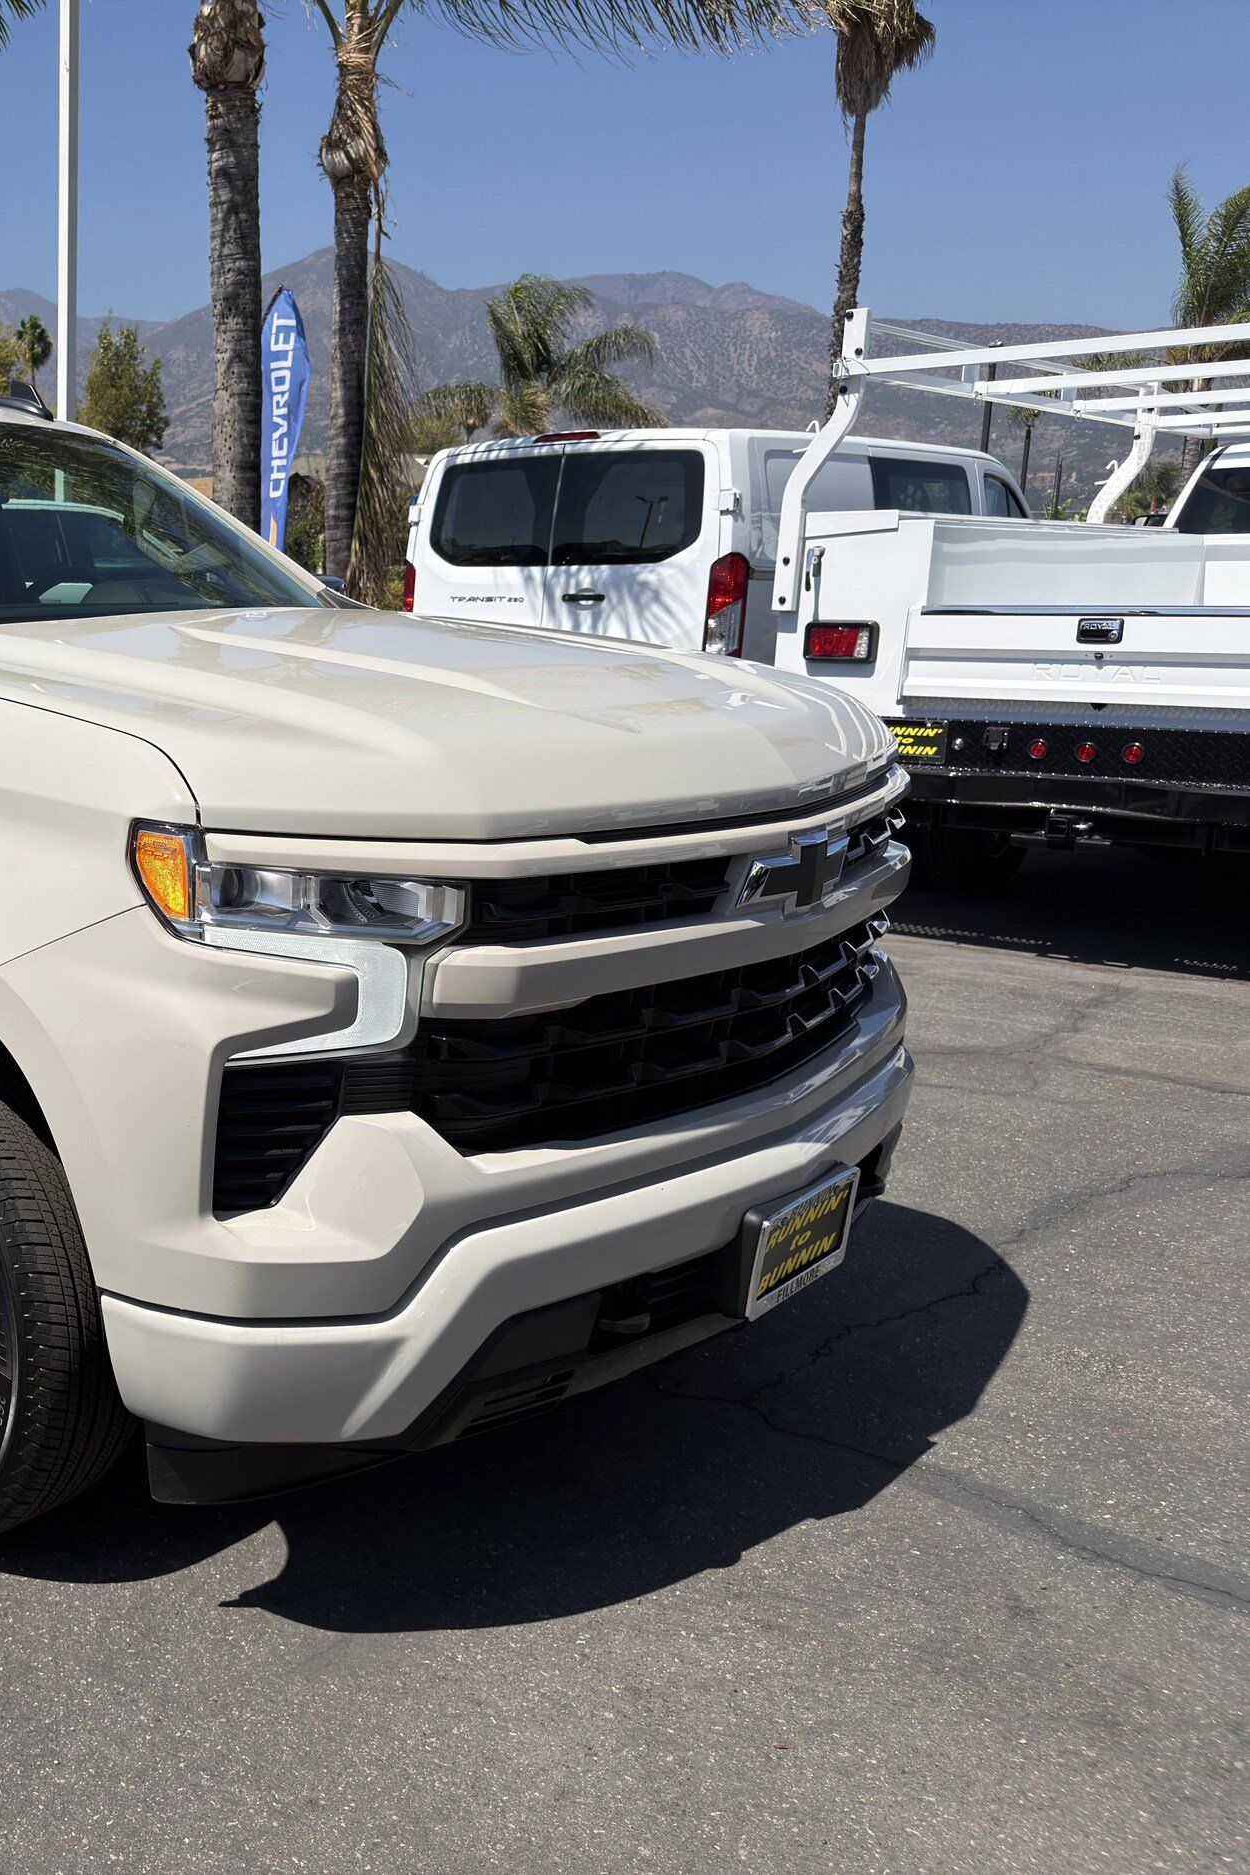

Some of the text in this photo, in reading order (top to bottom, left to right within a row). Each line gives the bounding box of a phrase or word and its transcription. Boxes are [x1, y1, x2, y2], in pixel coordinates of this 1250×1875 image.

[269, 312, 297, 499] CHEVROLET
[1032, 663, 1162, 682] ROYAL
[789, 1230, 811, 1251] to
[757, 1231, 837, 1297] BUNNIN
[776, 1265, 820, 1303] FILLMORE
